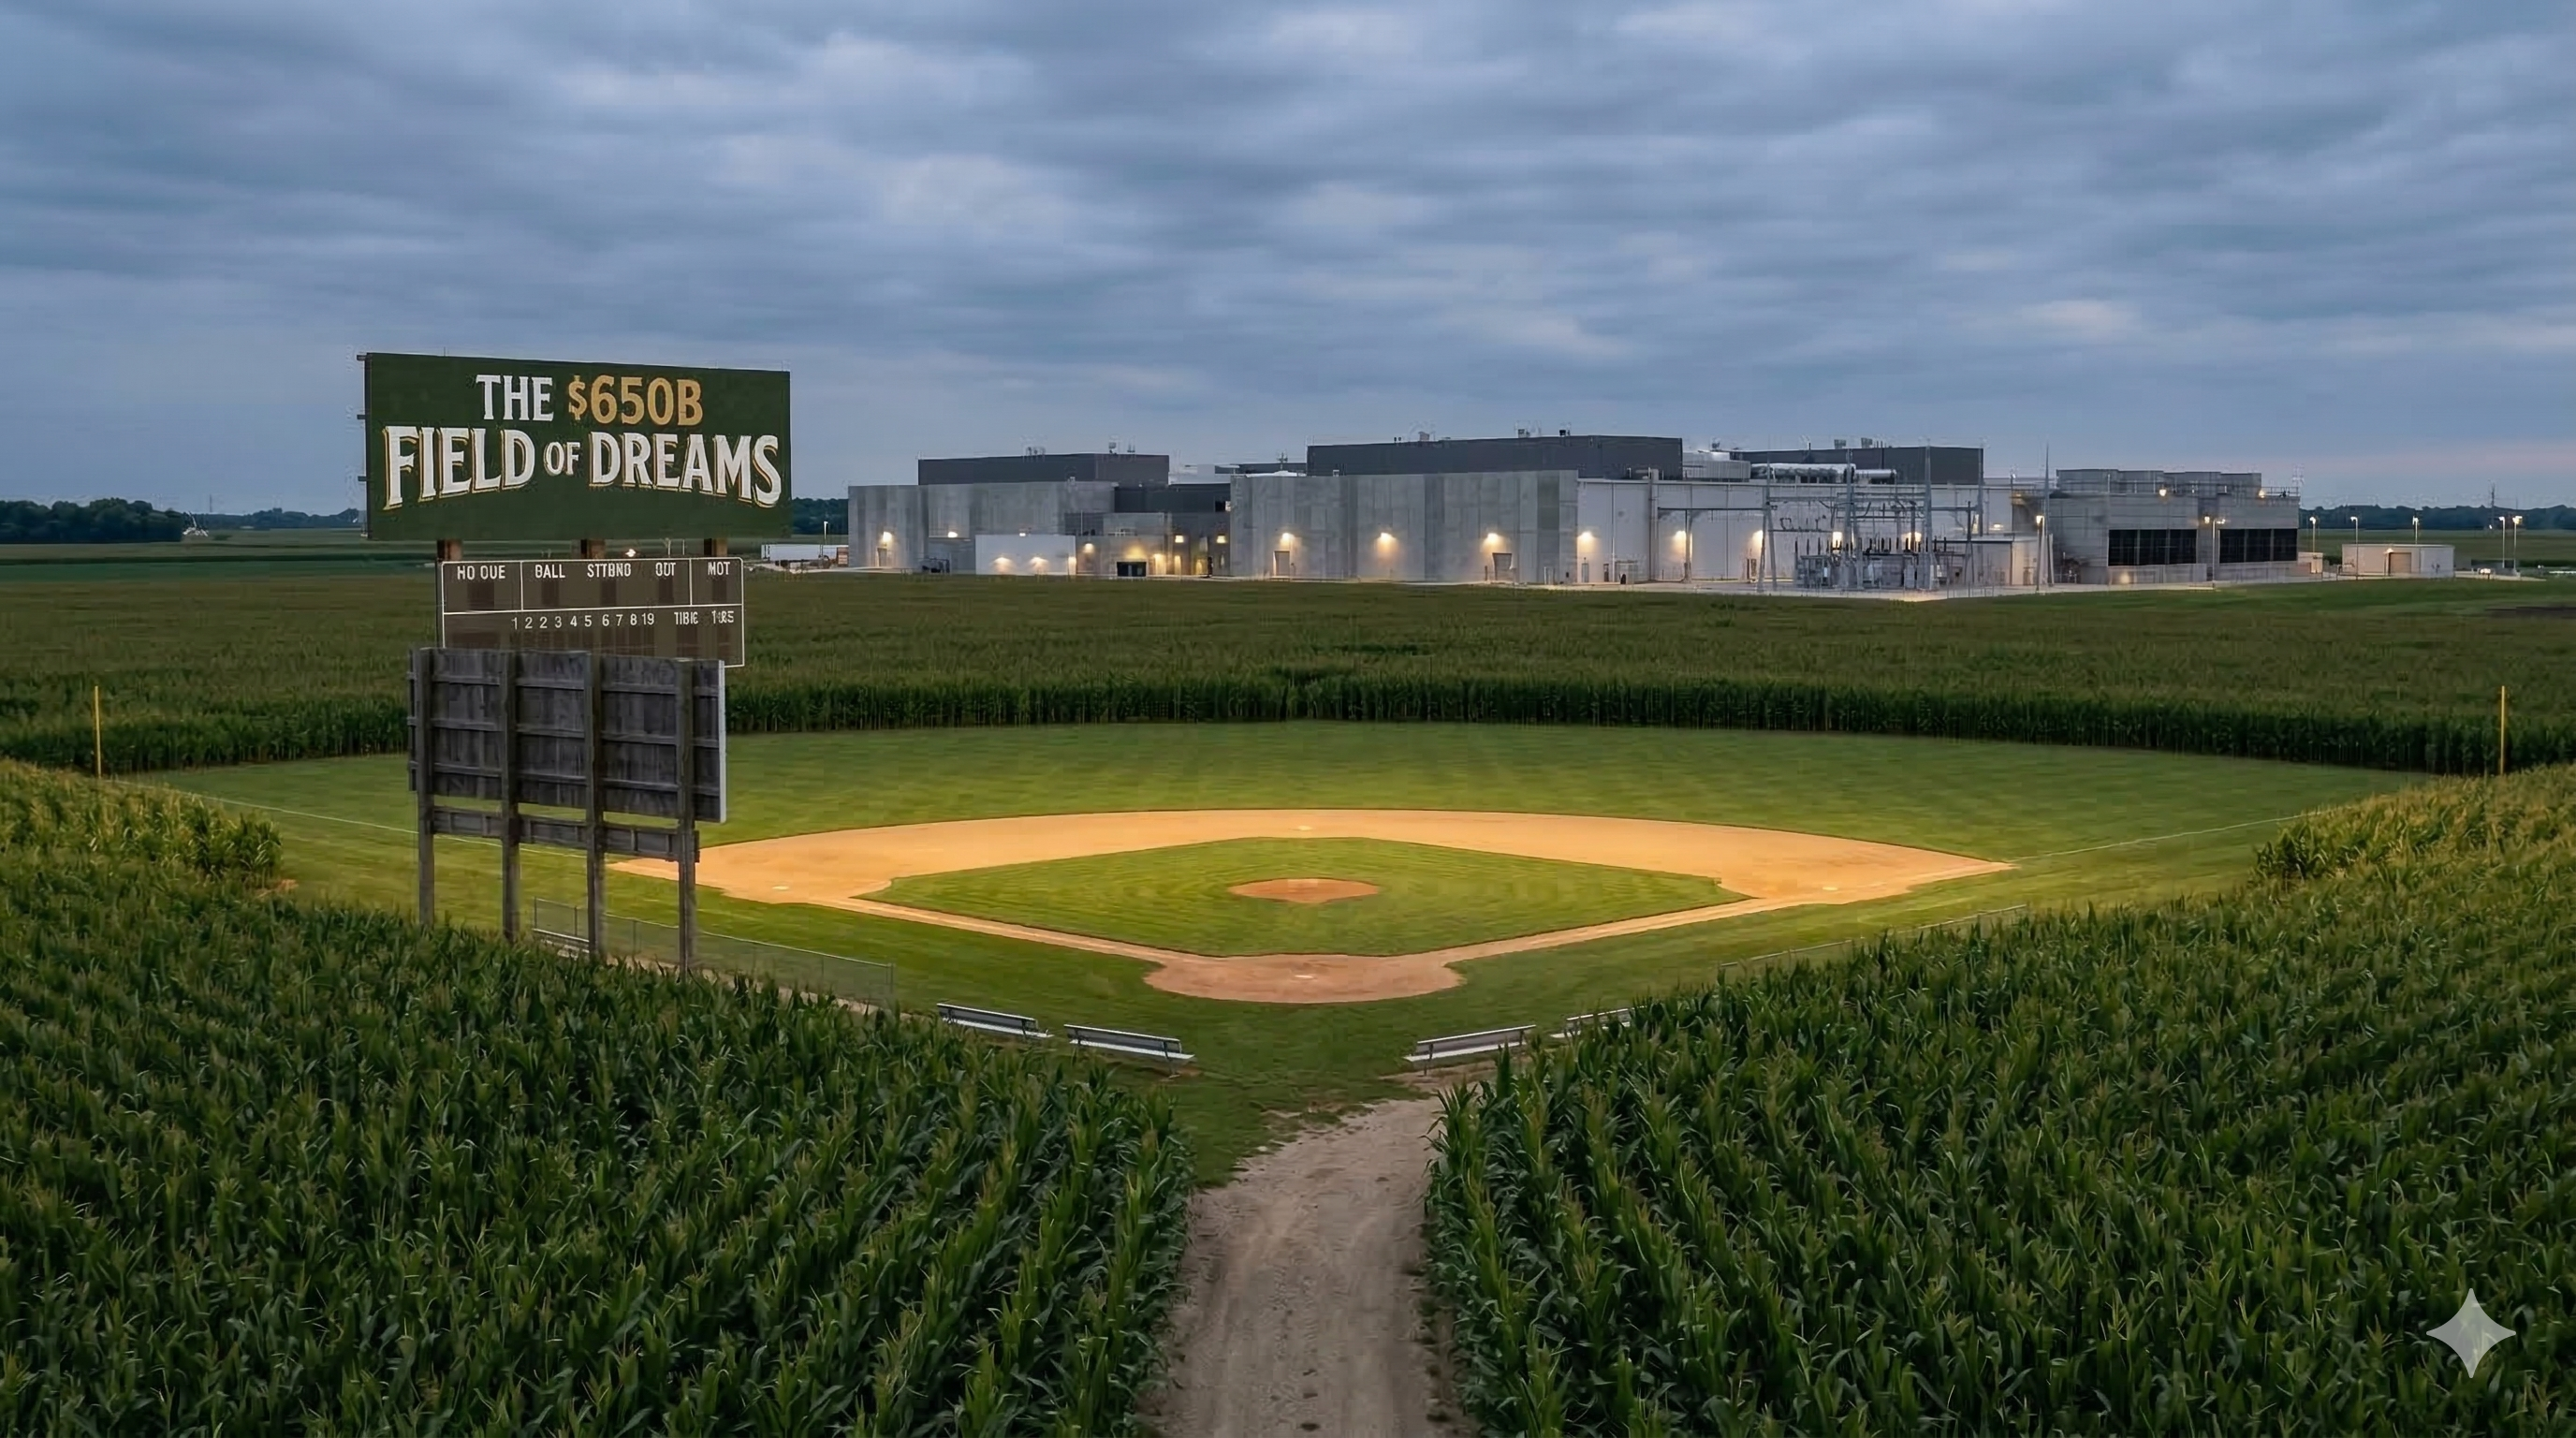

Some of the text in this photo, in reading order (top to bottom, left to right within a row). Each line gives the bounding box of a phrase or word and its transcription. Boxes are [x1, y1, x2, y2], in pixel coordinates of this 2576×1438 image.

[476, 374, 704, 426] THE $650B
[383, 425, 783, 510] FIELD OF DREAMS
[534, 564, 566, 579] BALL
[511, 617, 518, 630] 1
[524, 616, 533, 629] 2
[539, 616, 548, 629] 2
[554, 615, 563, 628] 3
[569, 615, 578, 627] 4
[584, 614, 593, 627] 5
[602, 613, 610, 626] 6
[615, 614, 623, 626] 7
[630, 613, 637, 626] 8
